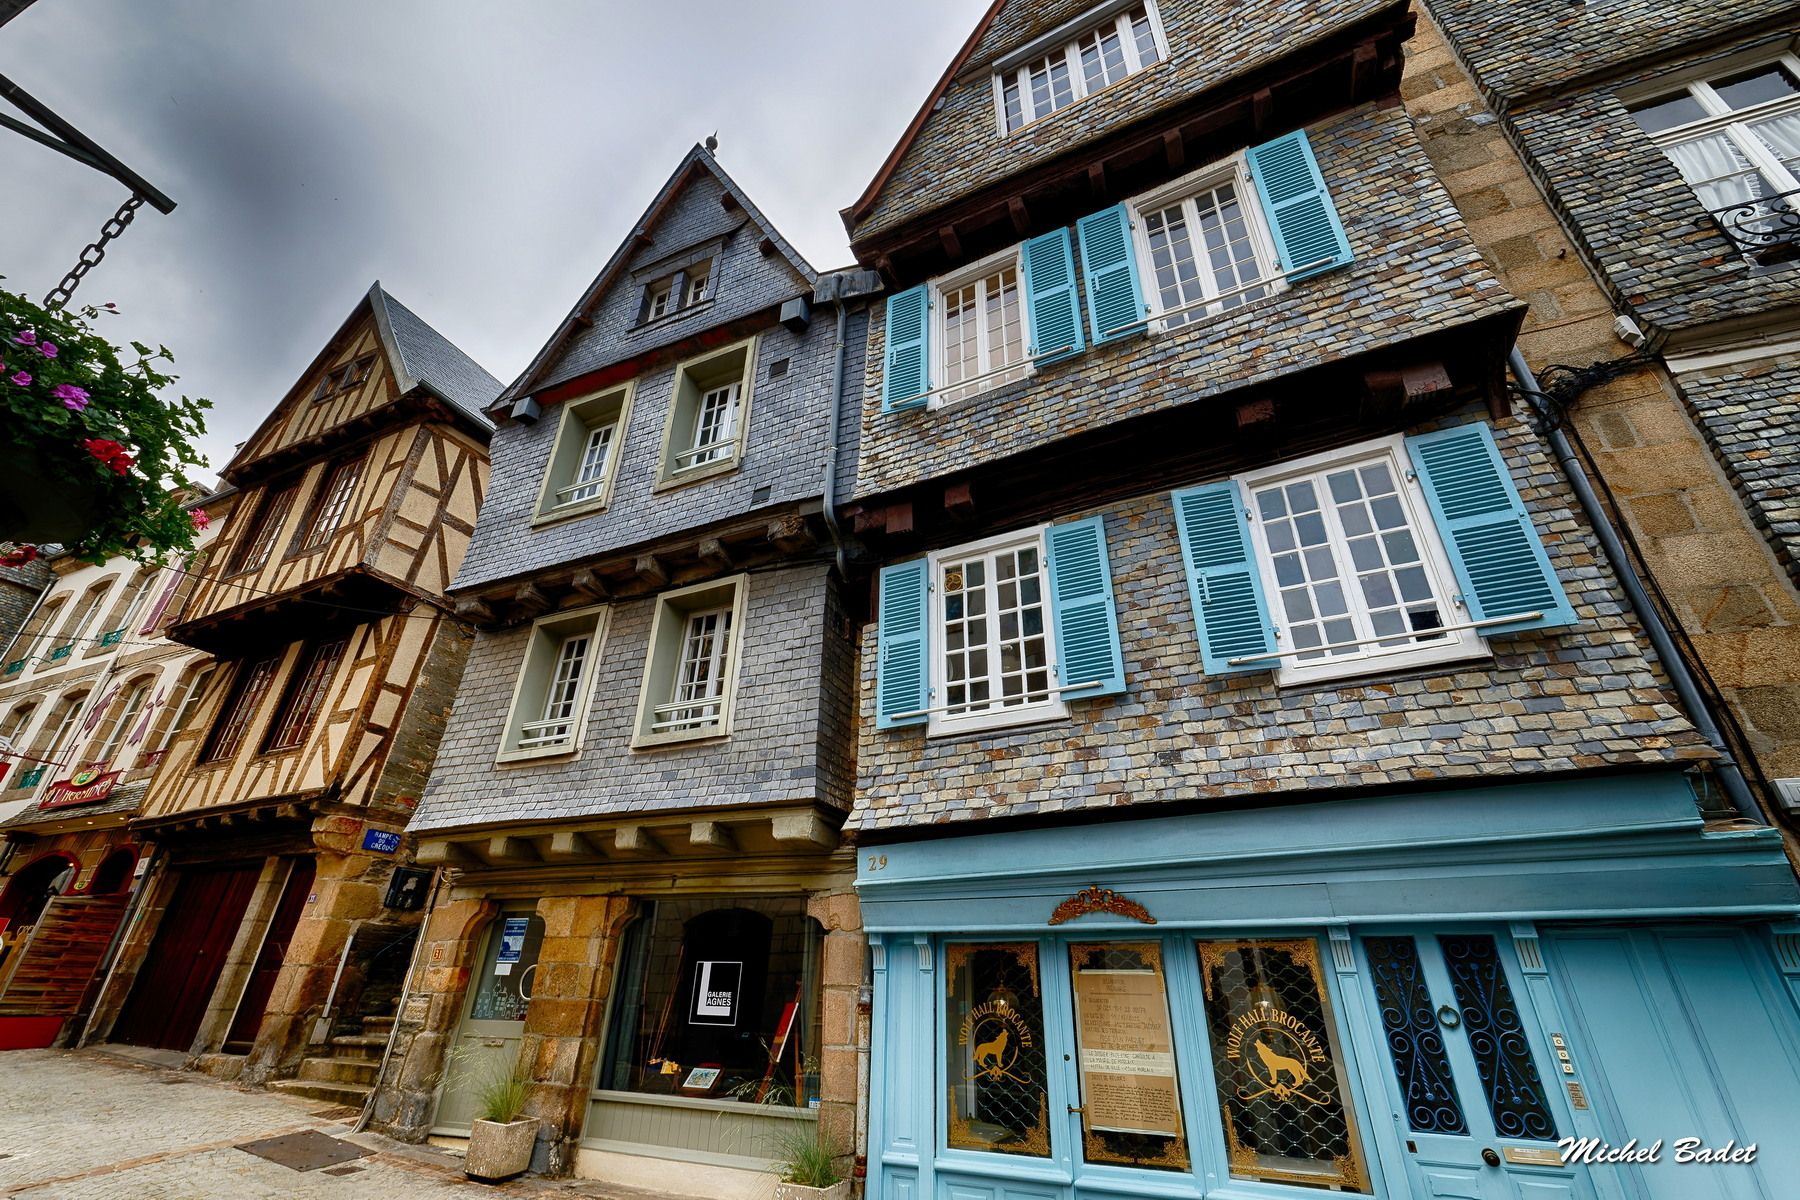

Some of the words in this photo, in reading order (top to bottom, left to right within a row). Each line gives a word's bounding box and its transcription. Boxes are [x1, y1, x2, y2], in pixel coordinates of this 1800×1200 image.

[374, 831, 394, 840] RAMPE
[868, 855, 888, 871] 29
[706, 997, 732, 1006] AGNES
[959, 1013, 975, 1046] WOLF
[971, 1001, 995, 1020] HALL
[996, 1002, 1033, 1048] BROCANTE
[1227, 1023, 1245, 1059] WOLF
[1238, 1007, 1270, 1029] HALL
[1271, 1008, 1326, 1063] BROCANTE
